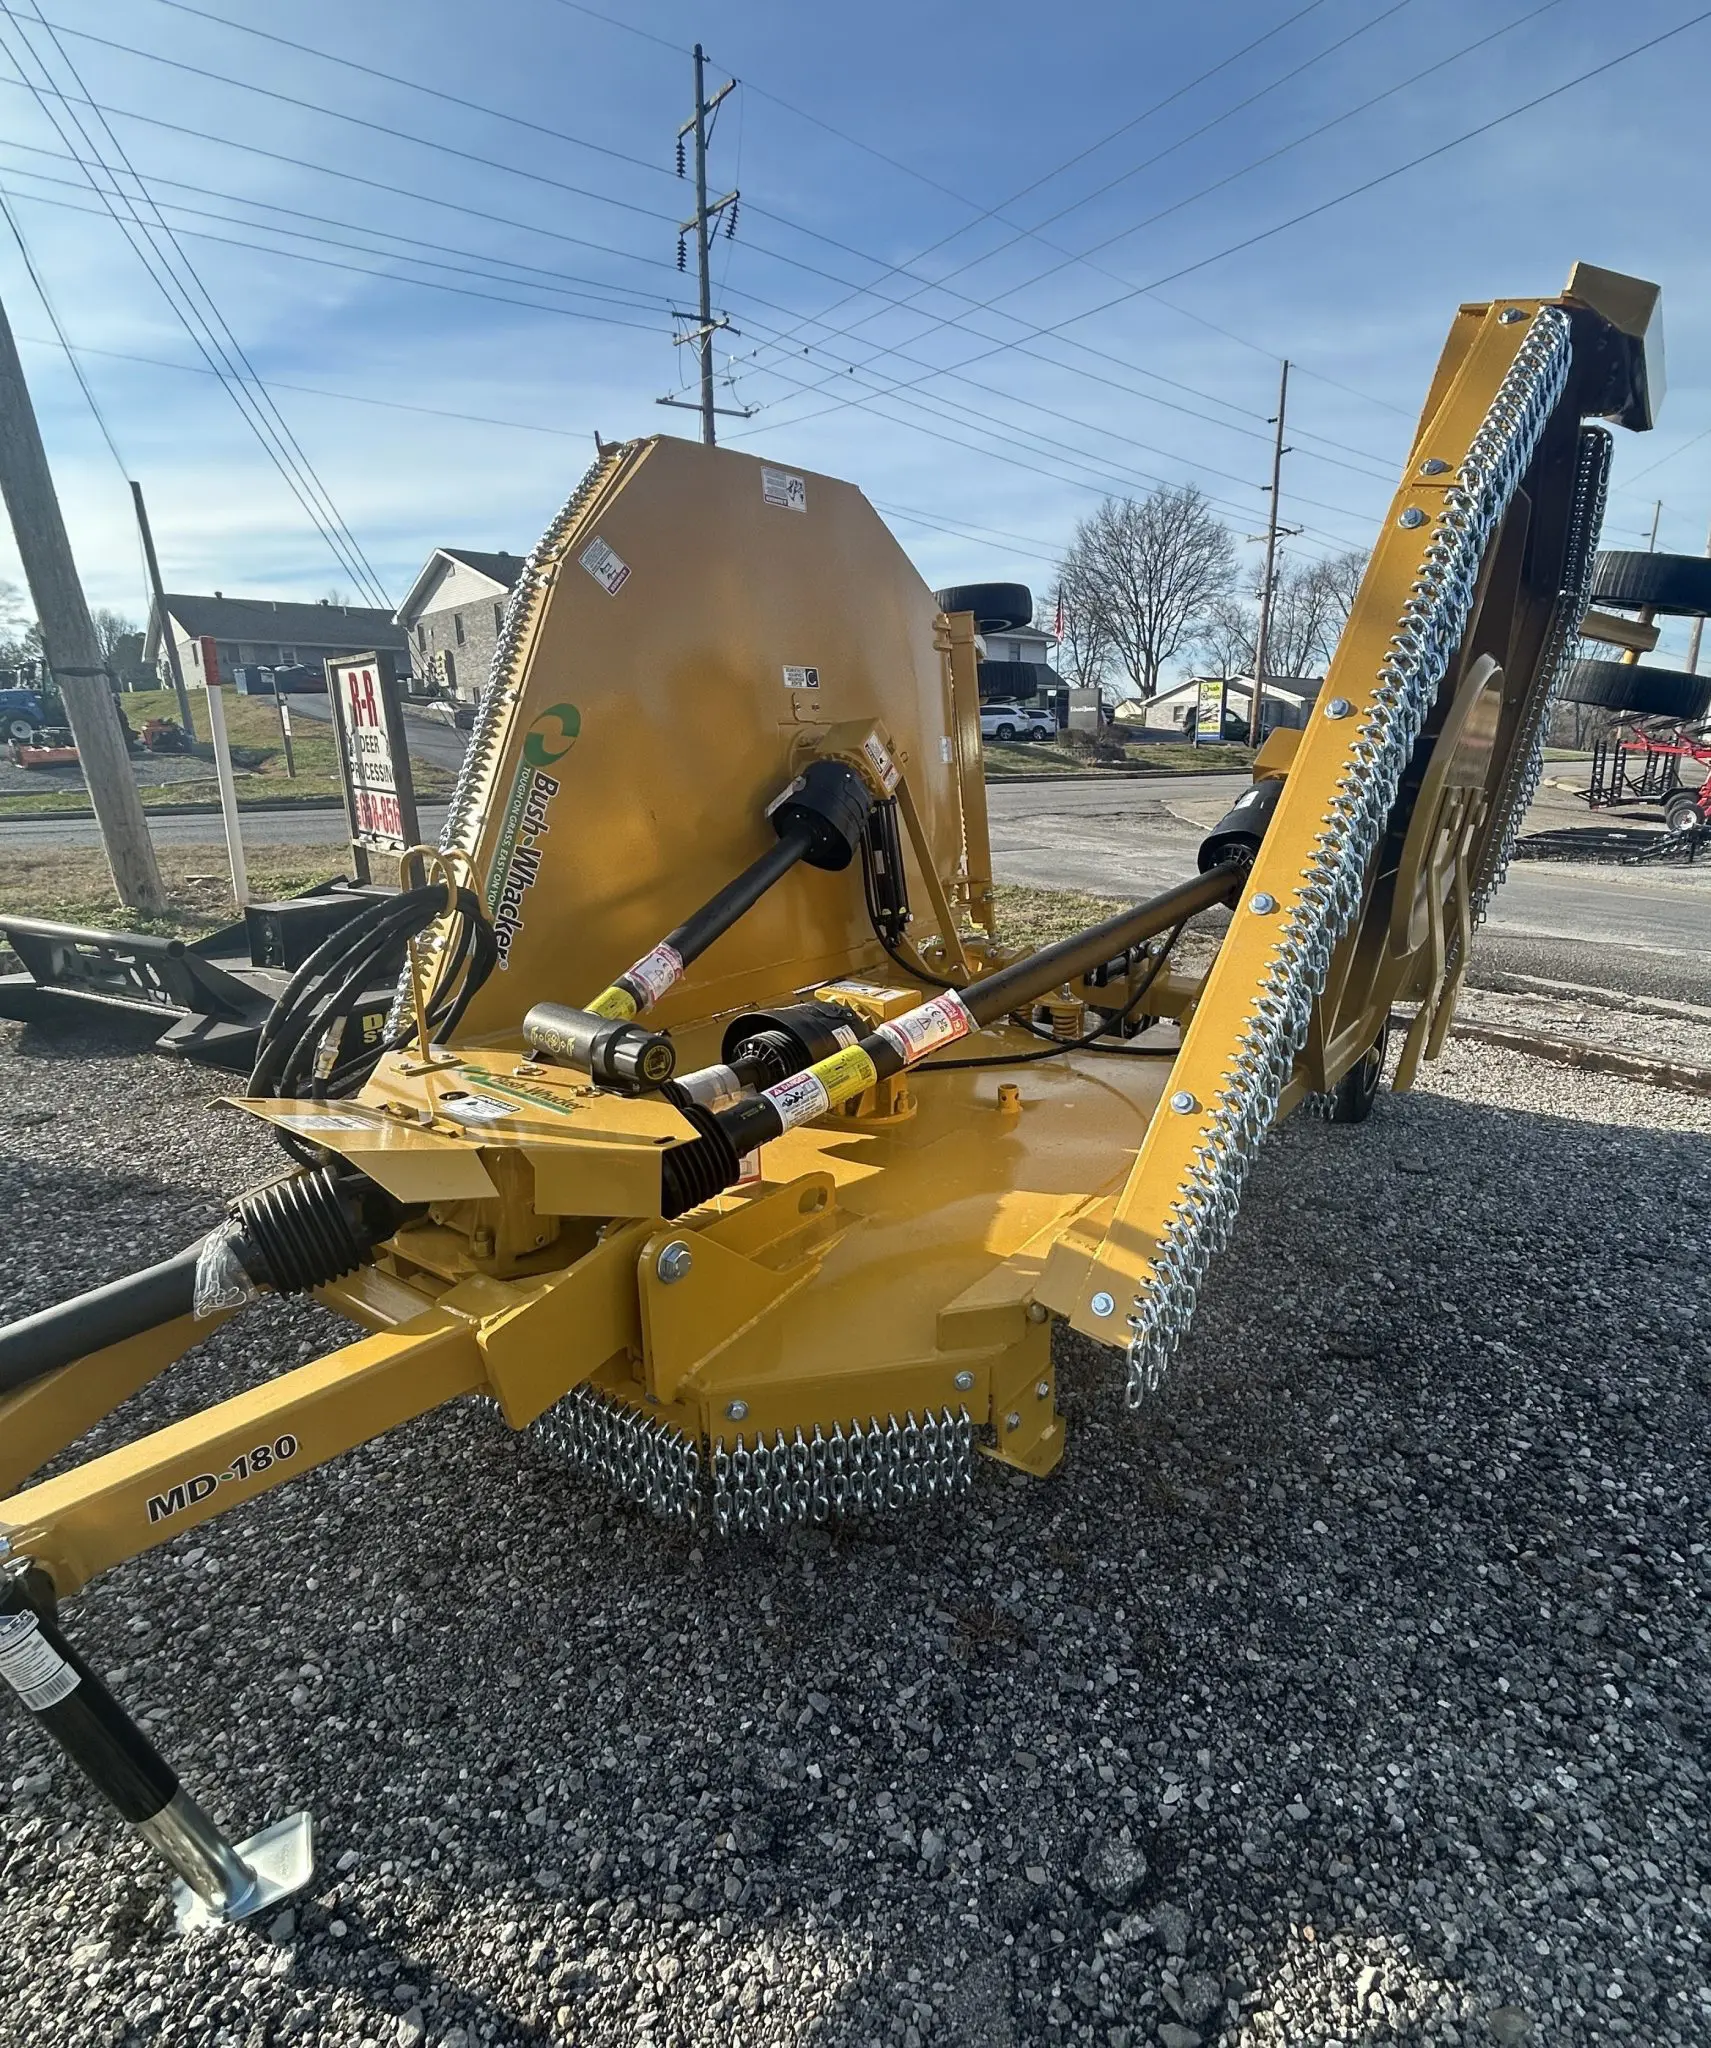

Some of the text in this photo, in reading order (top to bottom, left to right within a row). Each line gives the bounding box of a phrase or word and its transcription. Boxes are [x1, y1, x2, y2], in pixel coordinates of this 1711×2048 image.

[348, 669, 379, 727] R-R
[360, 734, 380, 754] DEER
[516, 766, 532, 799] TOUGH
[512, 799, 523, 814] ON
[504, 814, 518, 848] GRASS,
[497, 848, 509, 871] EASY
[493, 871, 502, 887] ON
[781, 1074, 809, 1091] DANGER
[147, 1434, 298, 1524] MD-180
